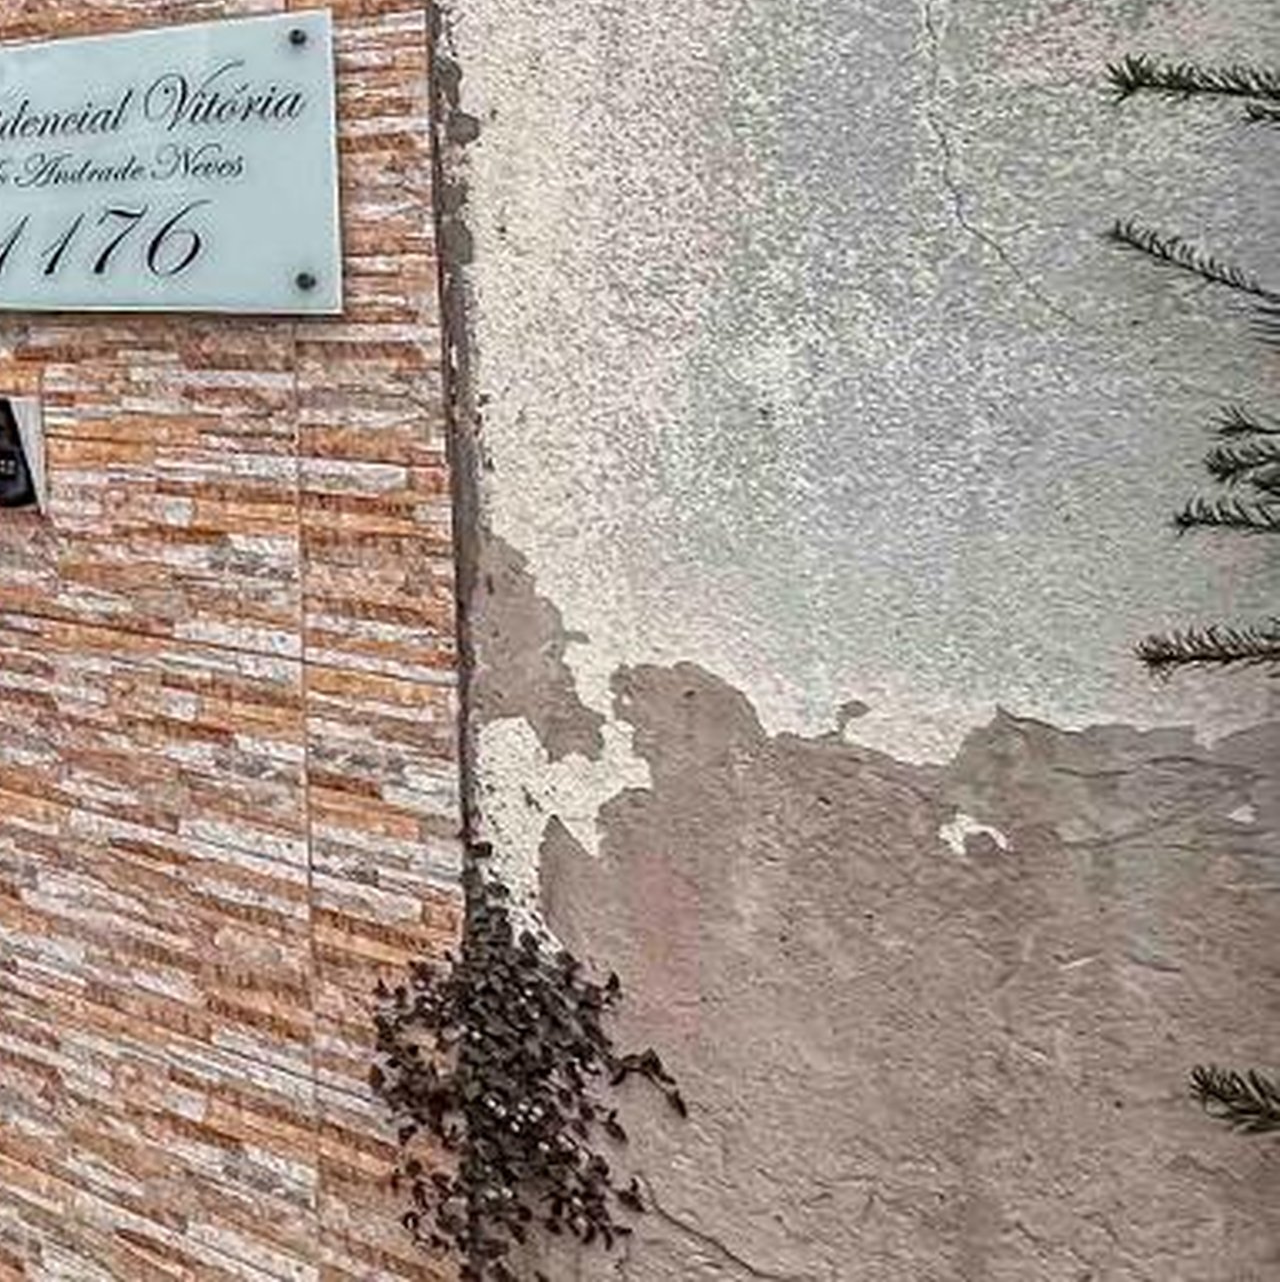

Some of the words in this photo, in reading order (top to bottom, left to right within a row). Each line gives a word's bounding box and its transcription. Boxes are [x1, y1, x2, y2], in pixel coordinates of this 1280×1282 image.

[144, 61, 306, 131] Vitória
[13, 152, 143, 188] Andrade
[151, 143, 244, 180] Neves
